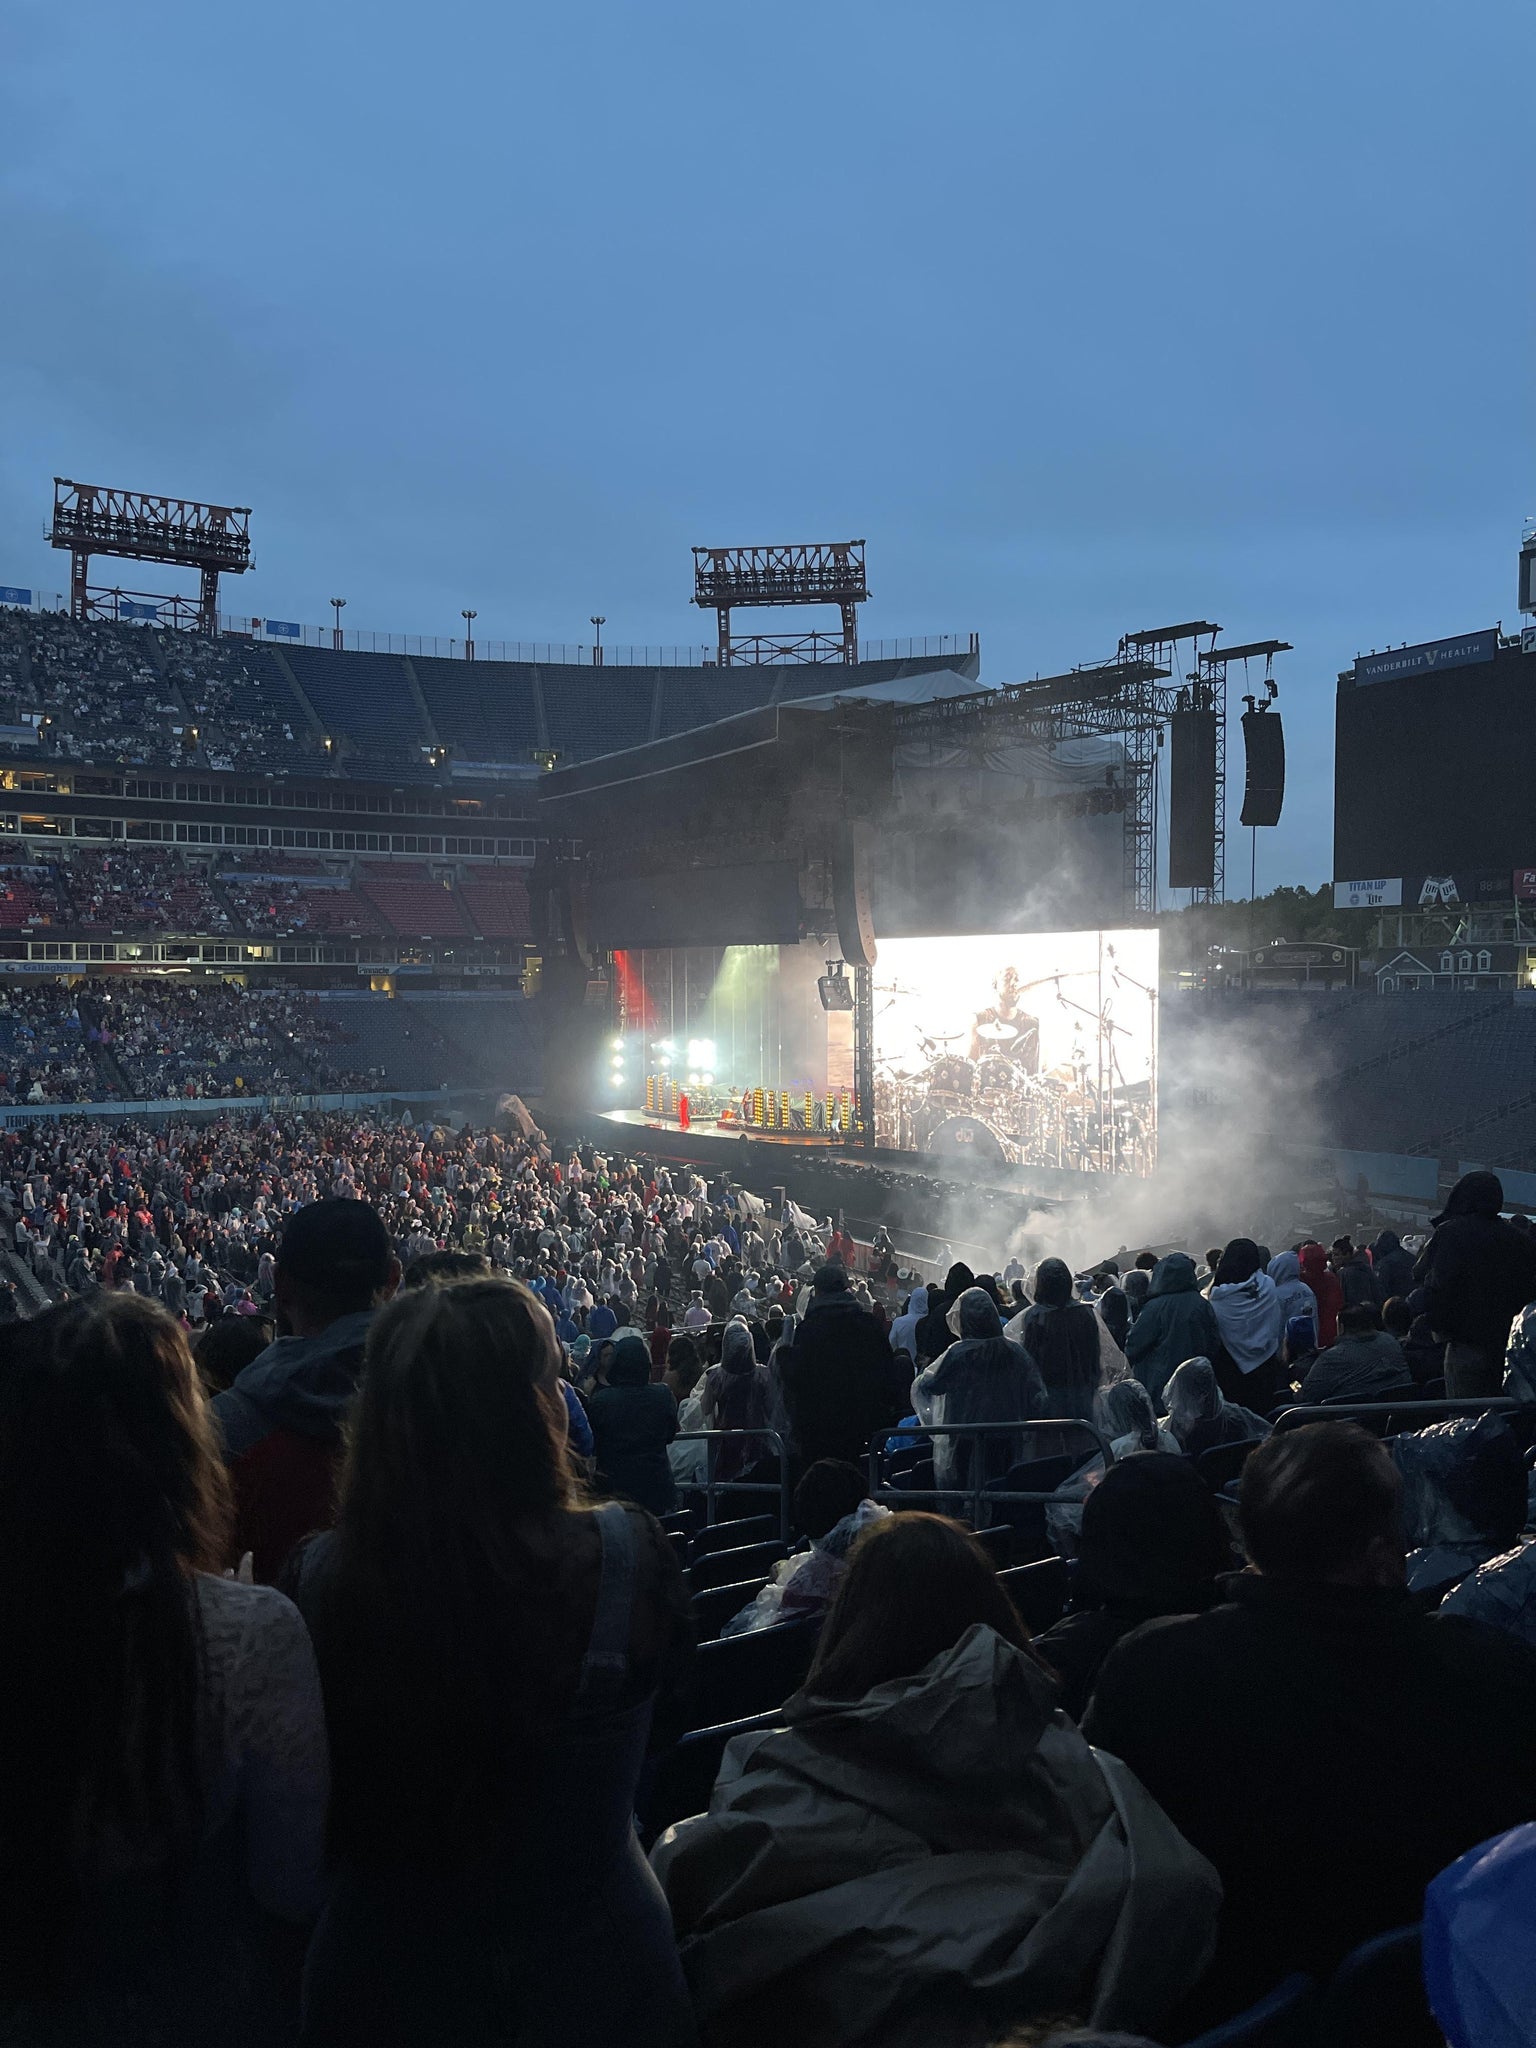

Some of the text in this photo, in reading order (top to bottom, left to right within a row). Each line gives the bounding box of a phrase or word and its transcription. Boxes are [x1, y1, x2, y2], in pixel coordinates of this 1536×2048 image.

[1366, 656, 1423, 675] VANDERBILT
[1440, 645, 1480, 660] HEALTH
[1349, 880, 1387, 892] TITAN UP
[23, 964, 73, 973] Gallagher
[358, 966, 390, 974] Pinnacle
